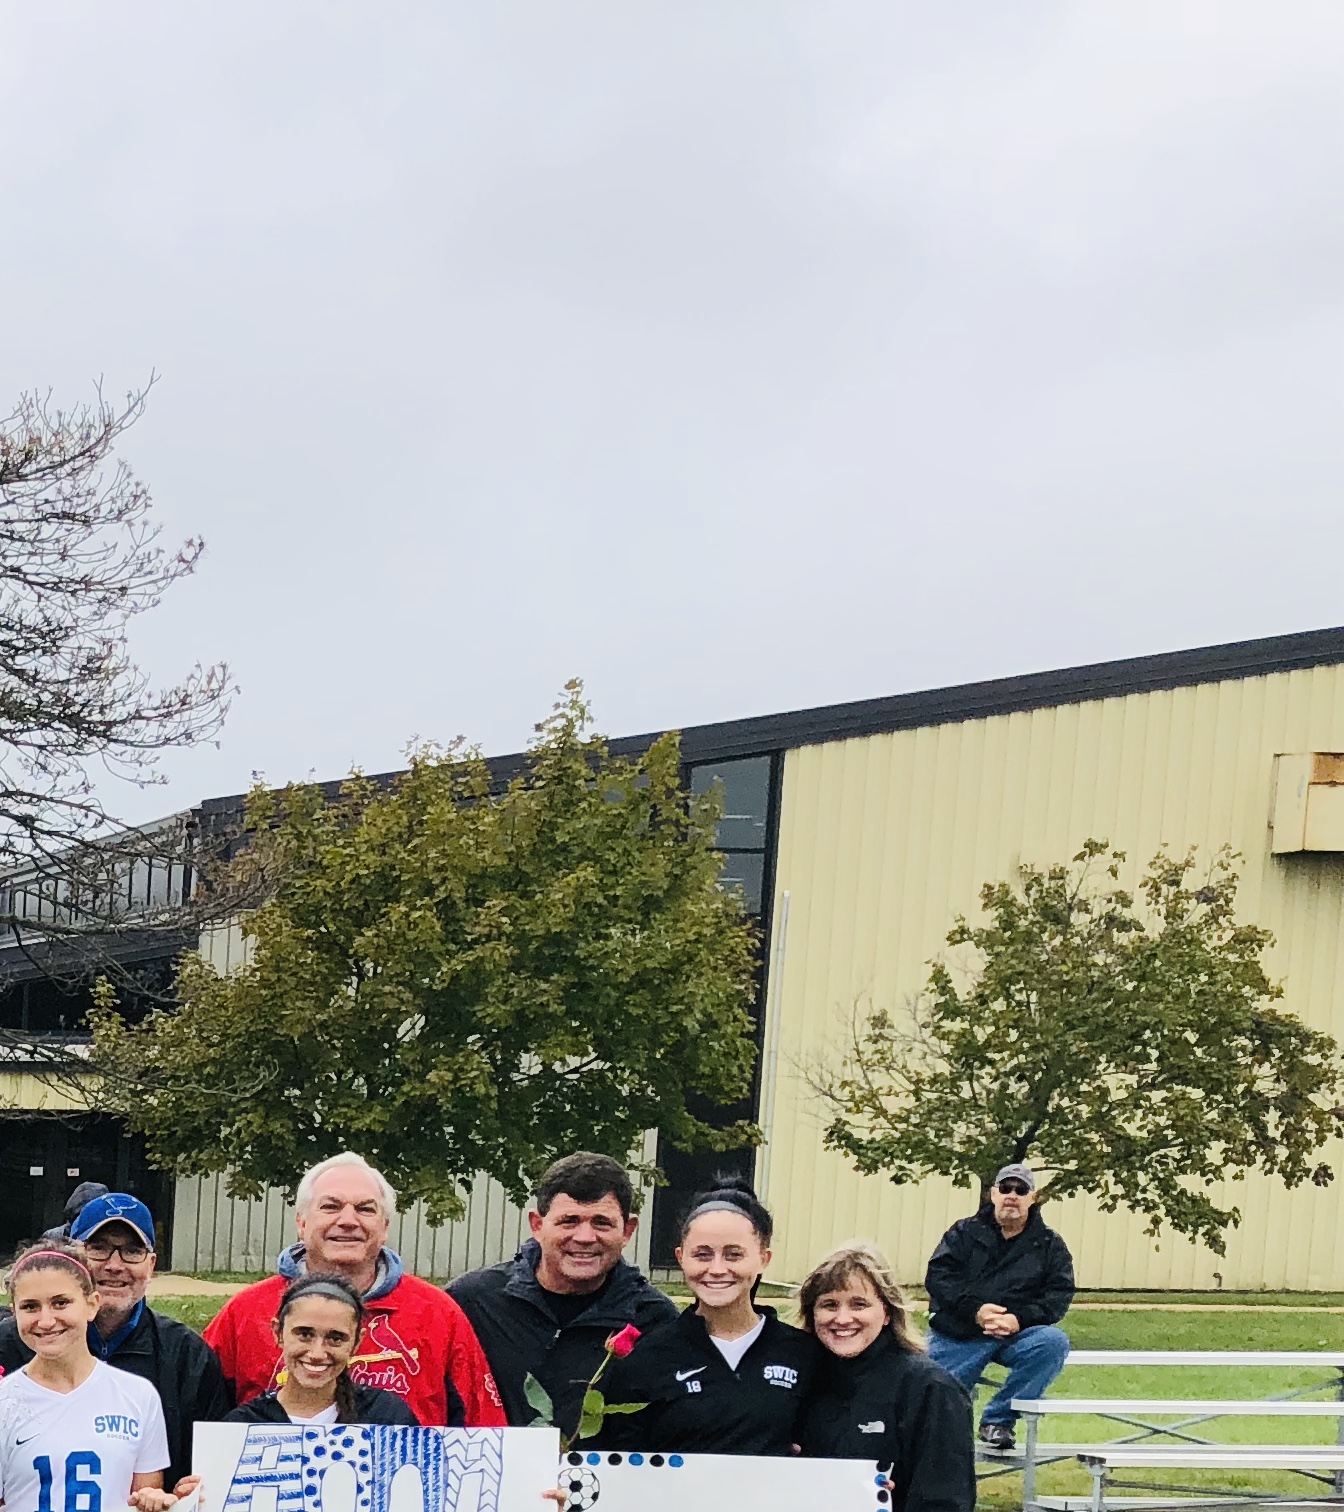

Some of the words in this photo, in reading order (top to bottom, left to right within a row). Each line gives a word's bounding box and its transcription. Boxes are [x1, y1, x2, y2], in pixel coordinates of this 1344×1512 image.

[763, 1365, 799, 1384] SWIC
[685, 1380, 702, 1393] 18
[93, 1414, 139, 1438] SWIC
